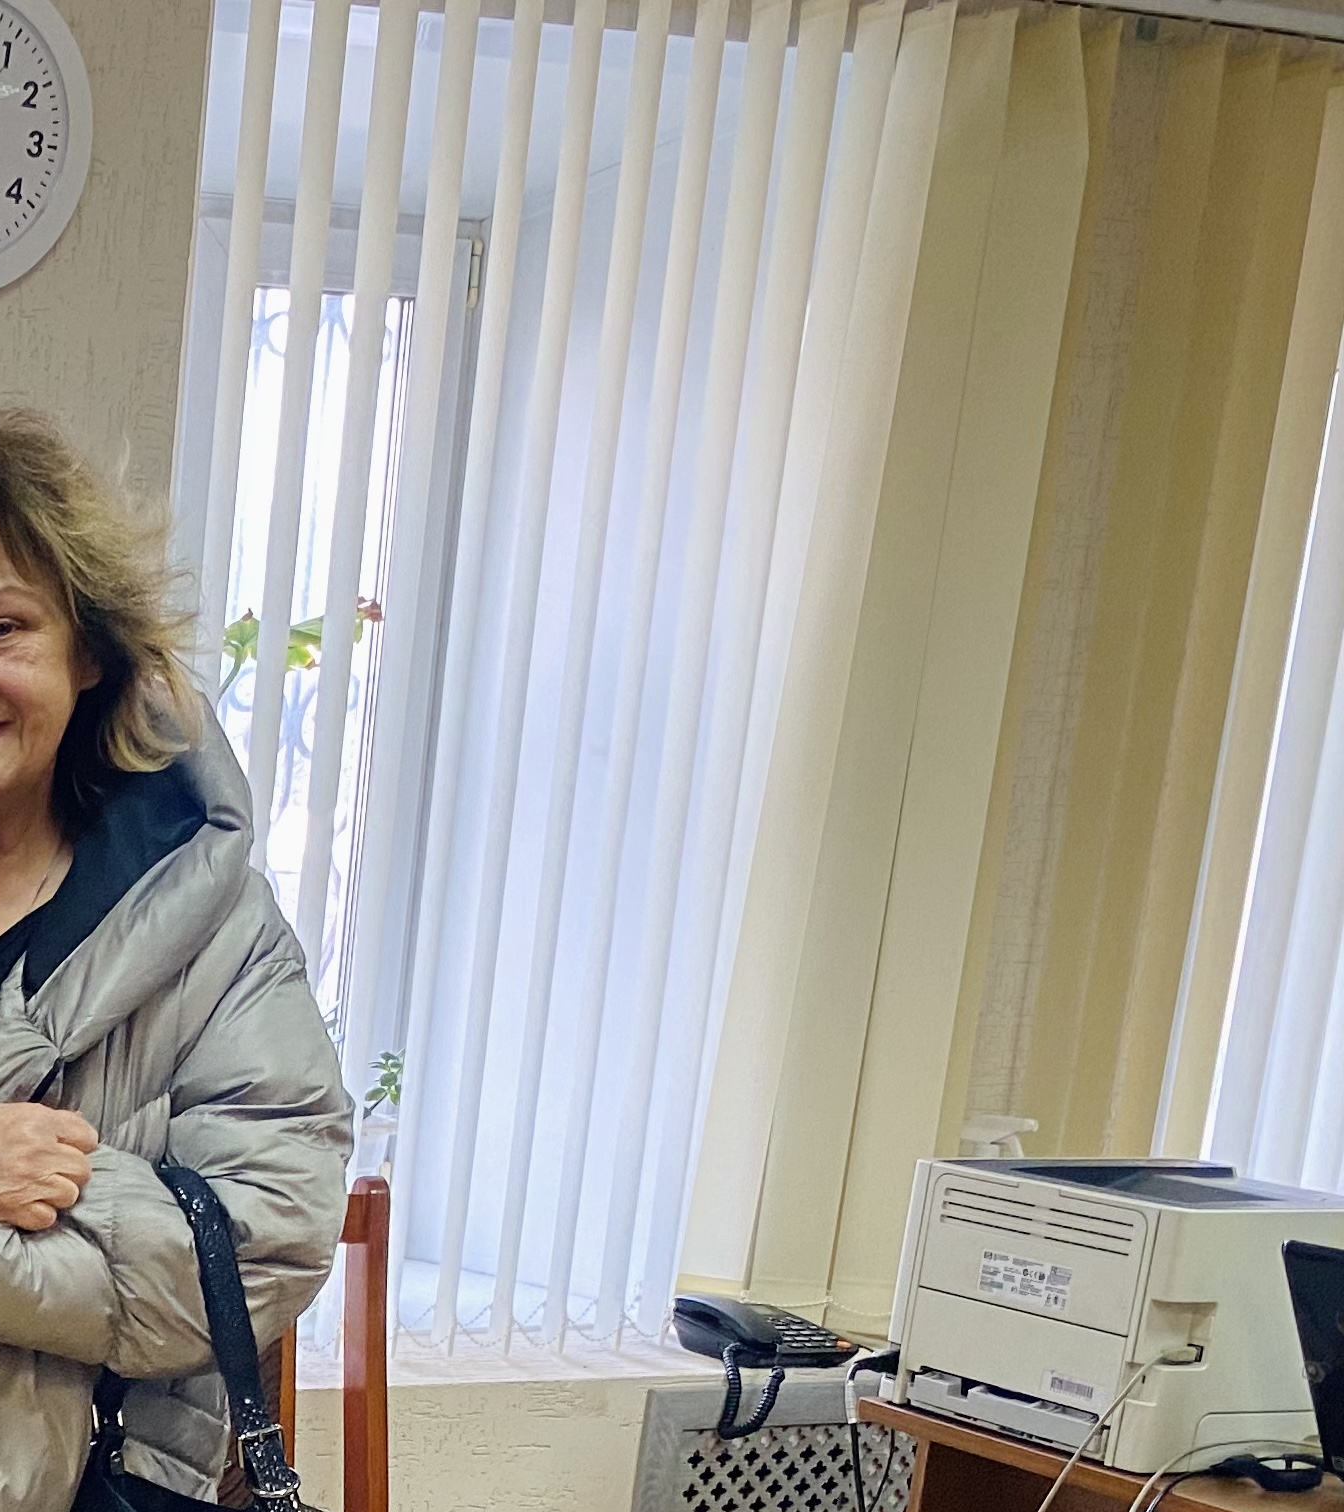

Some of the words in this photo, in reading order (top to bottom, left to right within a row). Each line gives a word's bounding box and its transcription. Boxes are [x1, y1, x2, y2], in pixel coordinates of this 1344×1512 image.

[2, 40, 12, 69] 1
[21, 80, 39, 109] 2
[26, 130, 44, 158] 3
[5, 177, 23, 205] 4
